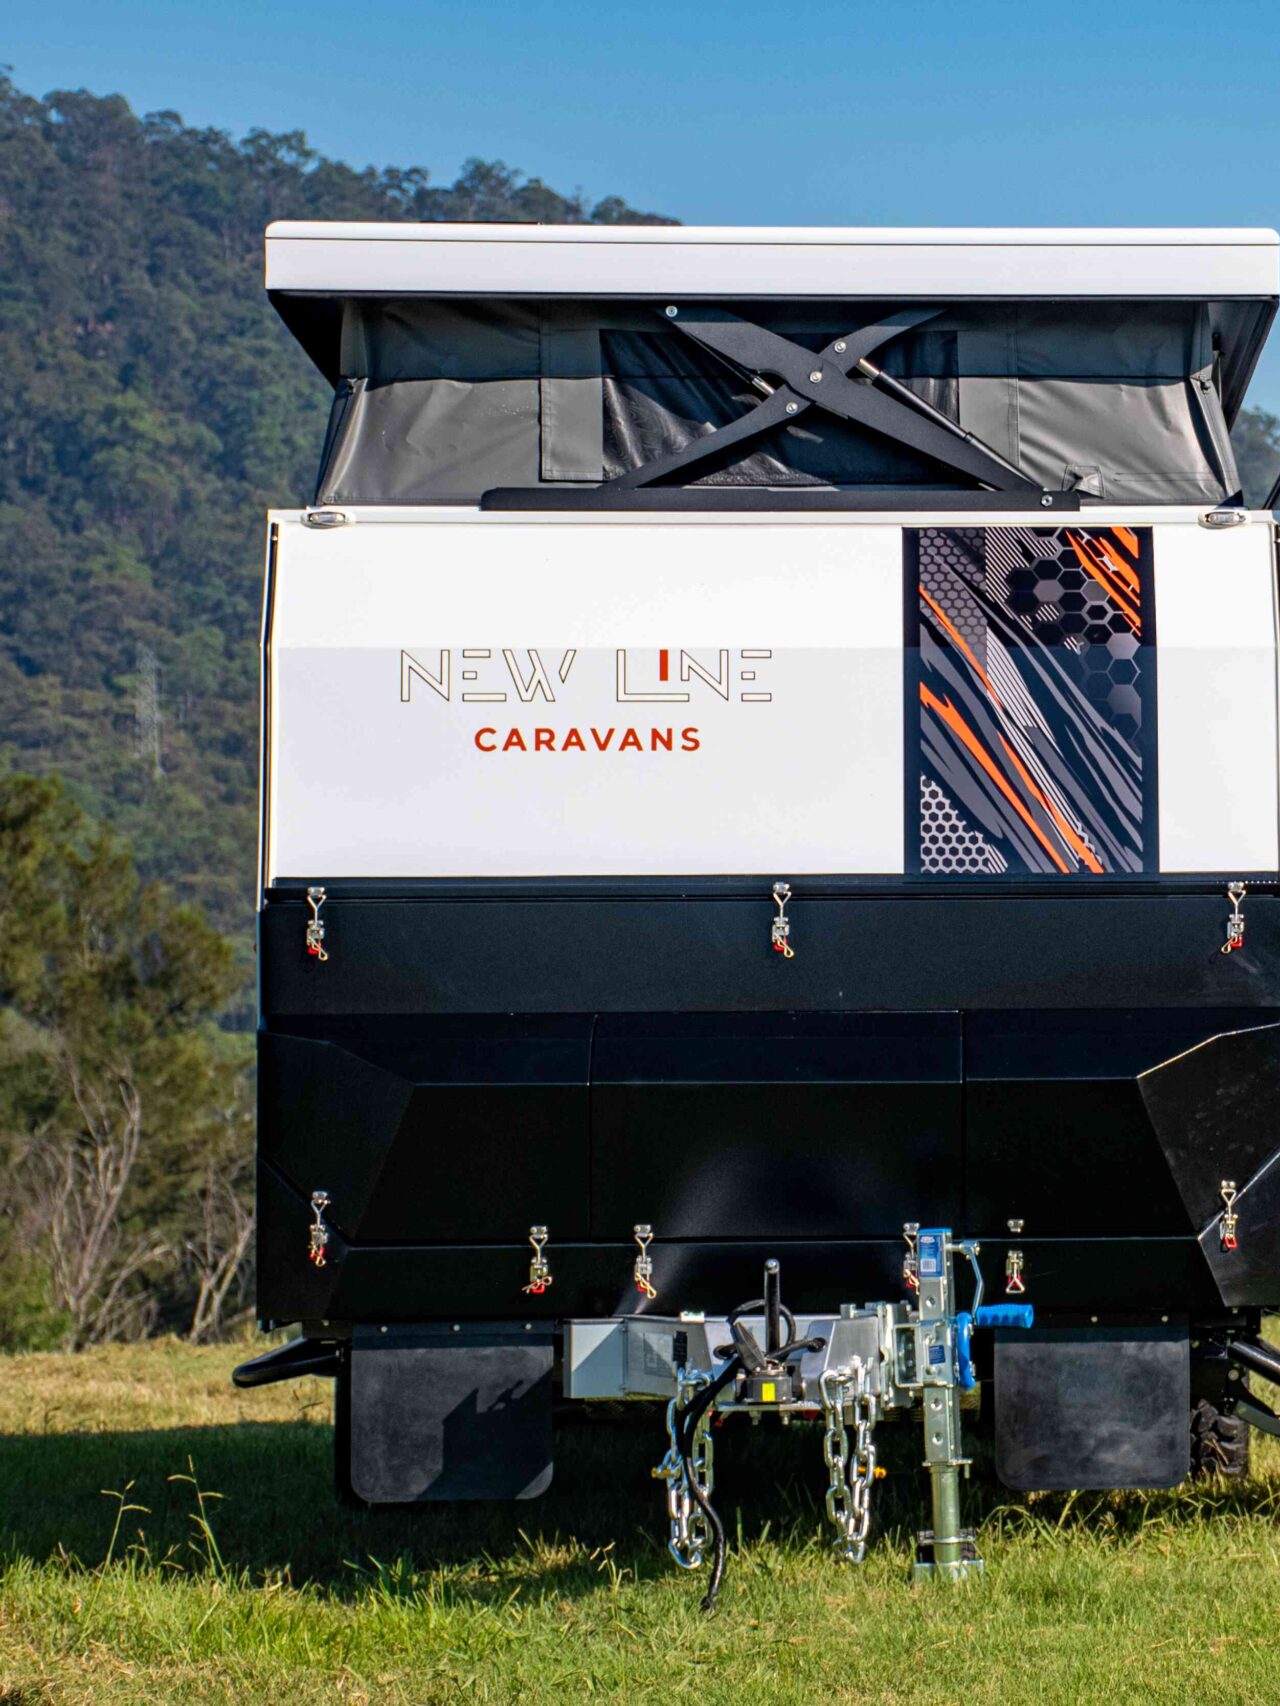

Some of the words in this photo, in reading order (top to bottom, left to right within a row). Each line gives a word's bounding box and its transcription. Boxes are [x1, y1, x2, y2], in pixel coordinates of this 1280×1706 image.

[400, 649, 577, 702] NEW
[616, 649, 772, 702] LINE
[474, 727, 701, 752] CARAVANS
